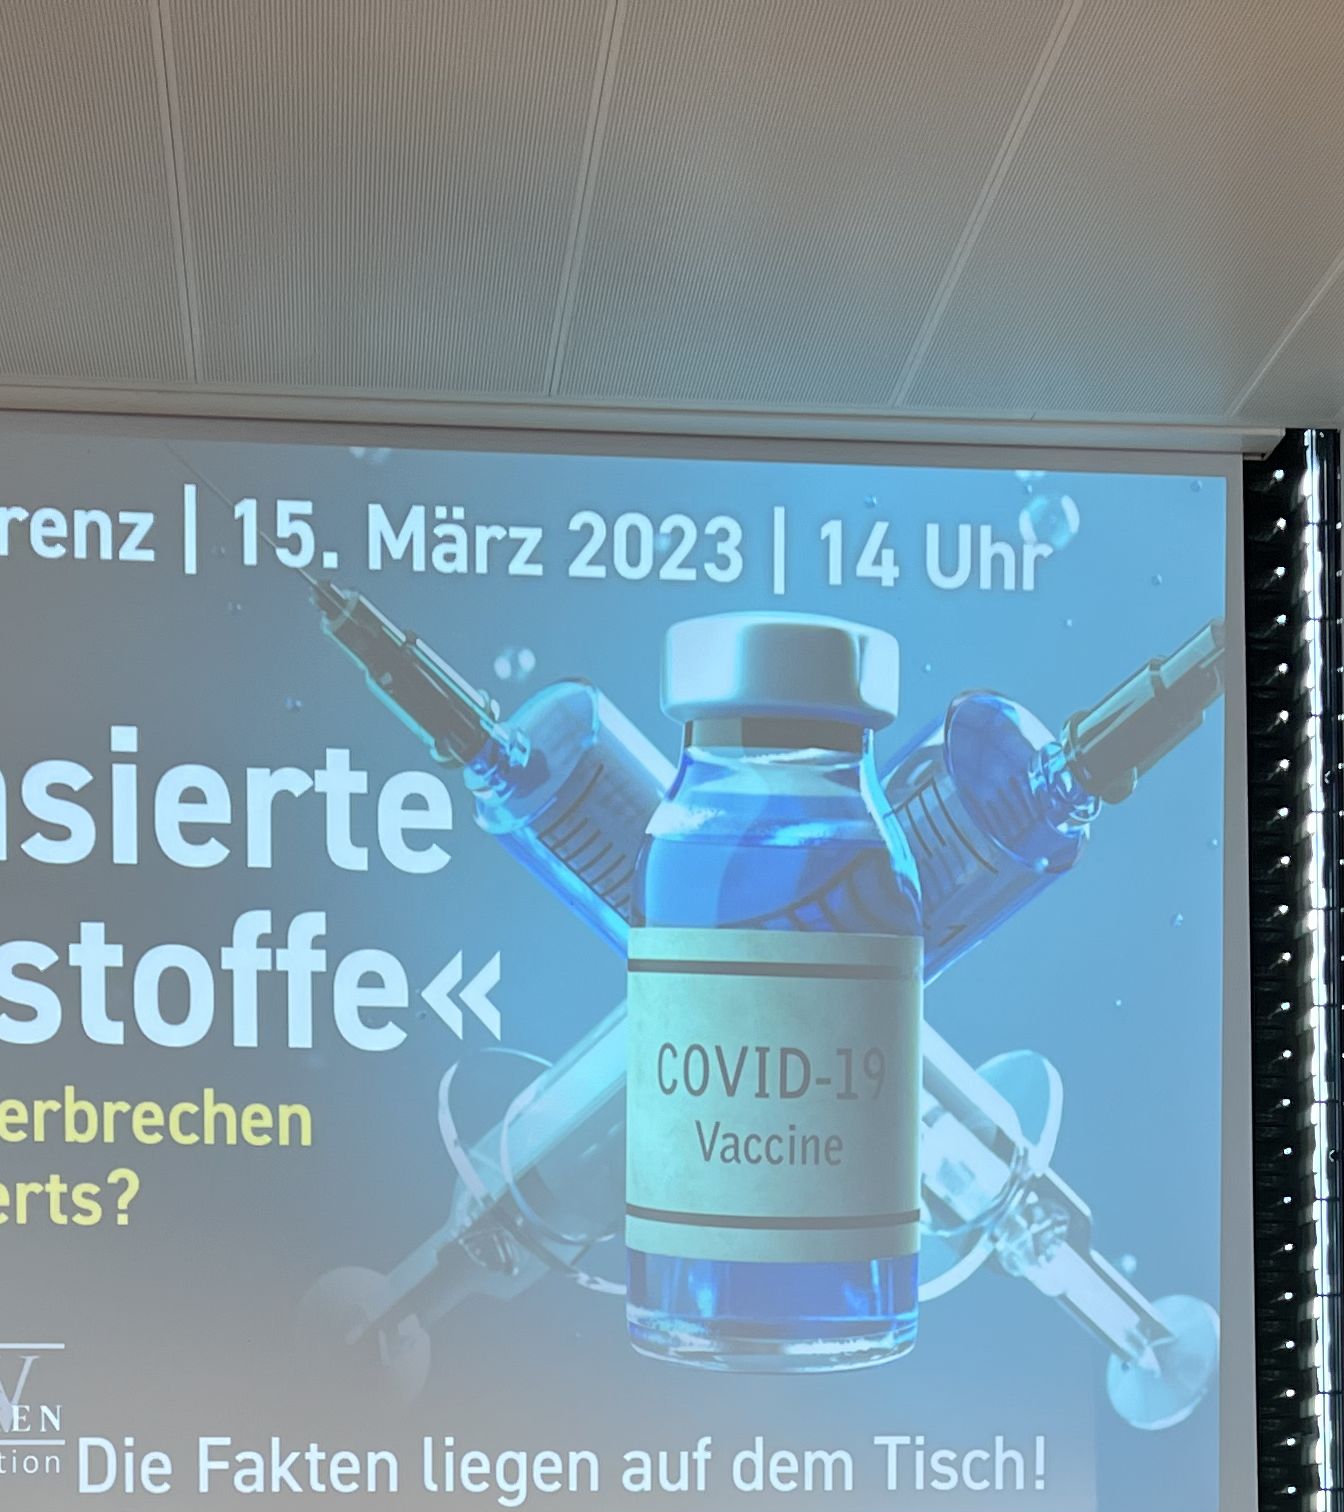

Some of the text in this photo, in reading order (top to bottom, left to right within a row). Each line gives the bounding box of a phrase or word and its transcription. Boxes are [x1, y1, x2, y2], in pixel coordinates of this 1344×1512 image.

[234, 498, 338, 569] 15.
[368, 503, 544, 576] März
[568, 510, 743, 583] 2023
[820, 519, 900, 587] 14
[927, 525, 1054, 591] Uhr
[658, 1042, 886, 1100] COVID-19
[695, 1119, 843, 1166] Vaccine
[78, 1435, 1048, 1508] Die Fakten liegen auf dem Tisch!
